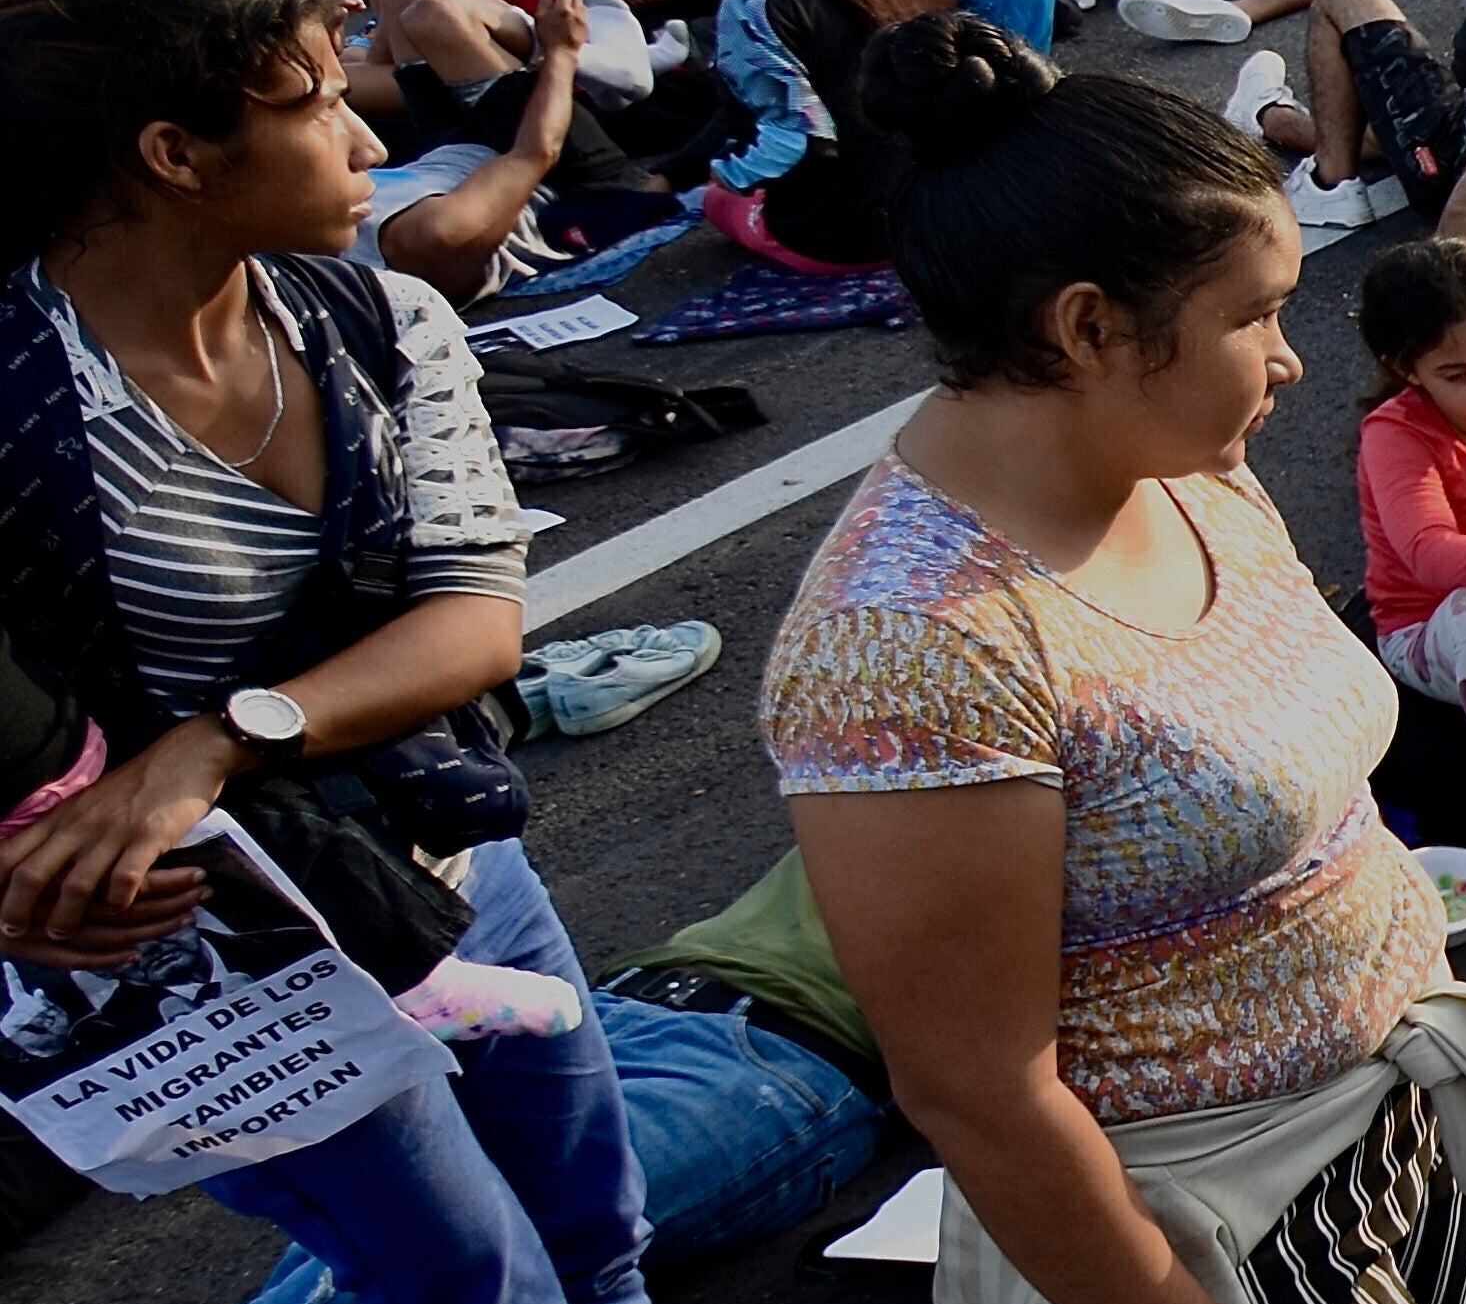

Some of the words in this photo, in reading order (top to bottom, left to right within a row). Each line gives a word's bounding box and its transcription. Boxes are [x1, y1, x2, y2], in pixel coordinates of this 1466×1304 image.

[51, 1079, 109, 1110] LA
[108, 1029, 205, 1082] VIDA
[205, 996, 261, 1031] DE
[263, 959, 338, 1003] LOS
[114, 1001, 332, 1123] MIGRANTES
[169, 1039, 334, 1131] TAMBIEN
[173, 1061, 363, 1159] IMPORTAN
